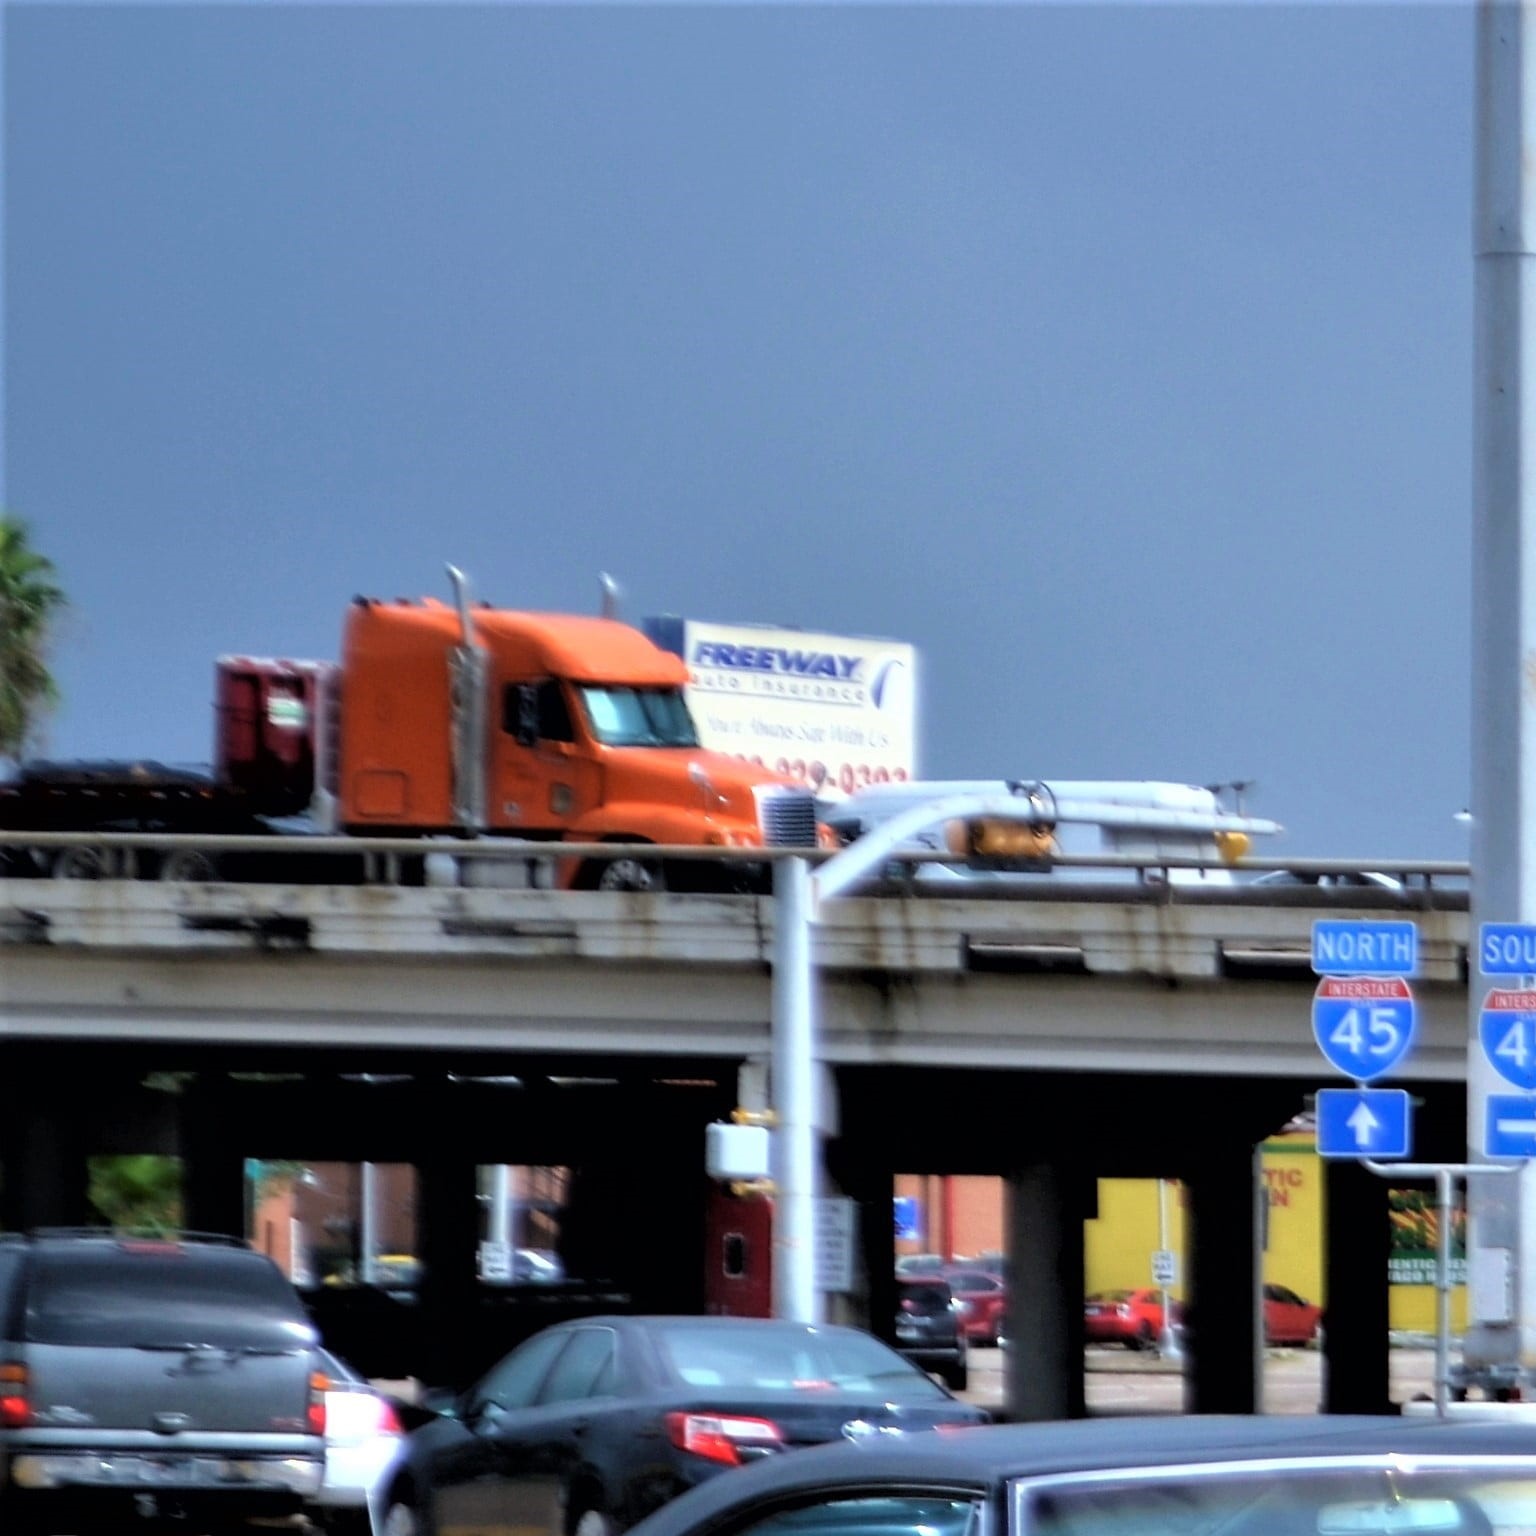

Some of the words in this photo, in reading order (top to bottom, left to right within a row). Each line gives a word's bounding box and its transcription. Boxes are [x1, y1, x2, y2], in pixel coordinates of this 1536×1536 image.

[695, 643, 864, 677] FREEWAY
[691, 673, 739, 689] auto
[752, 676, 865, 701] insurance
[1317, 932, 1411, 961] NORTH
[1328, 983, 1398, 997] INTERSTATE
[1329, 1007, 1399, 1055] 45
